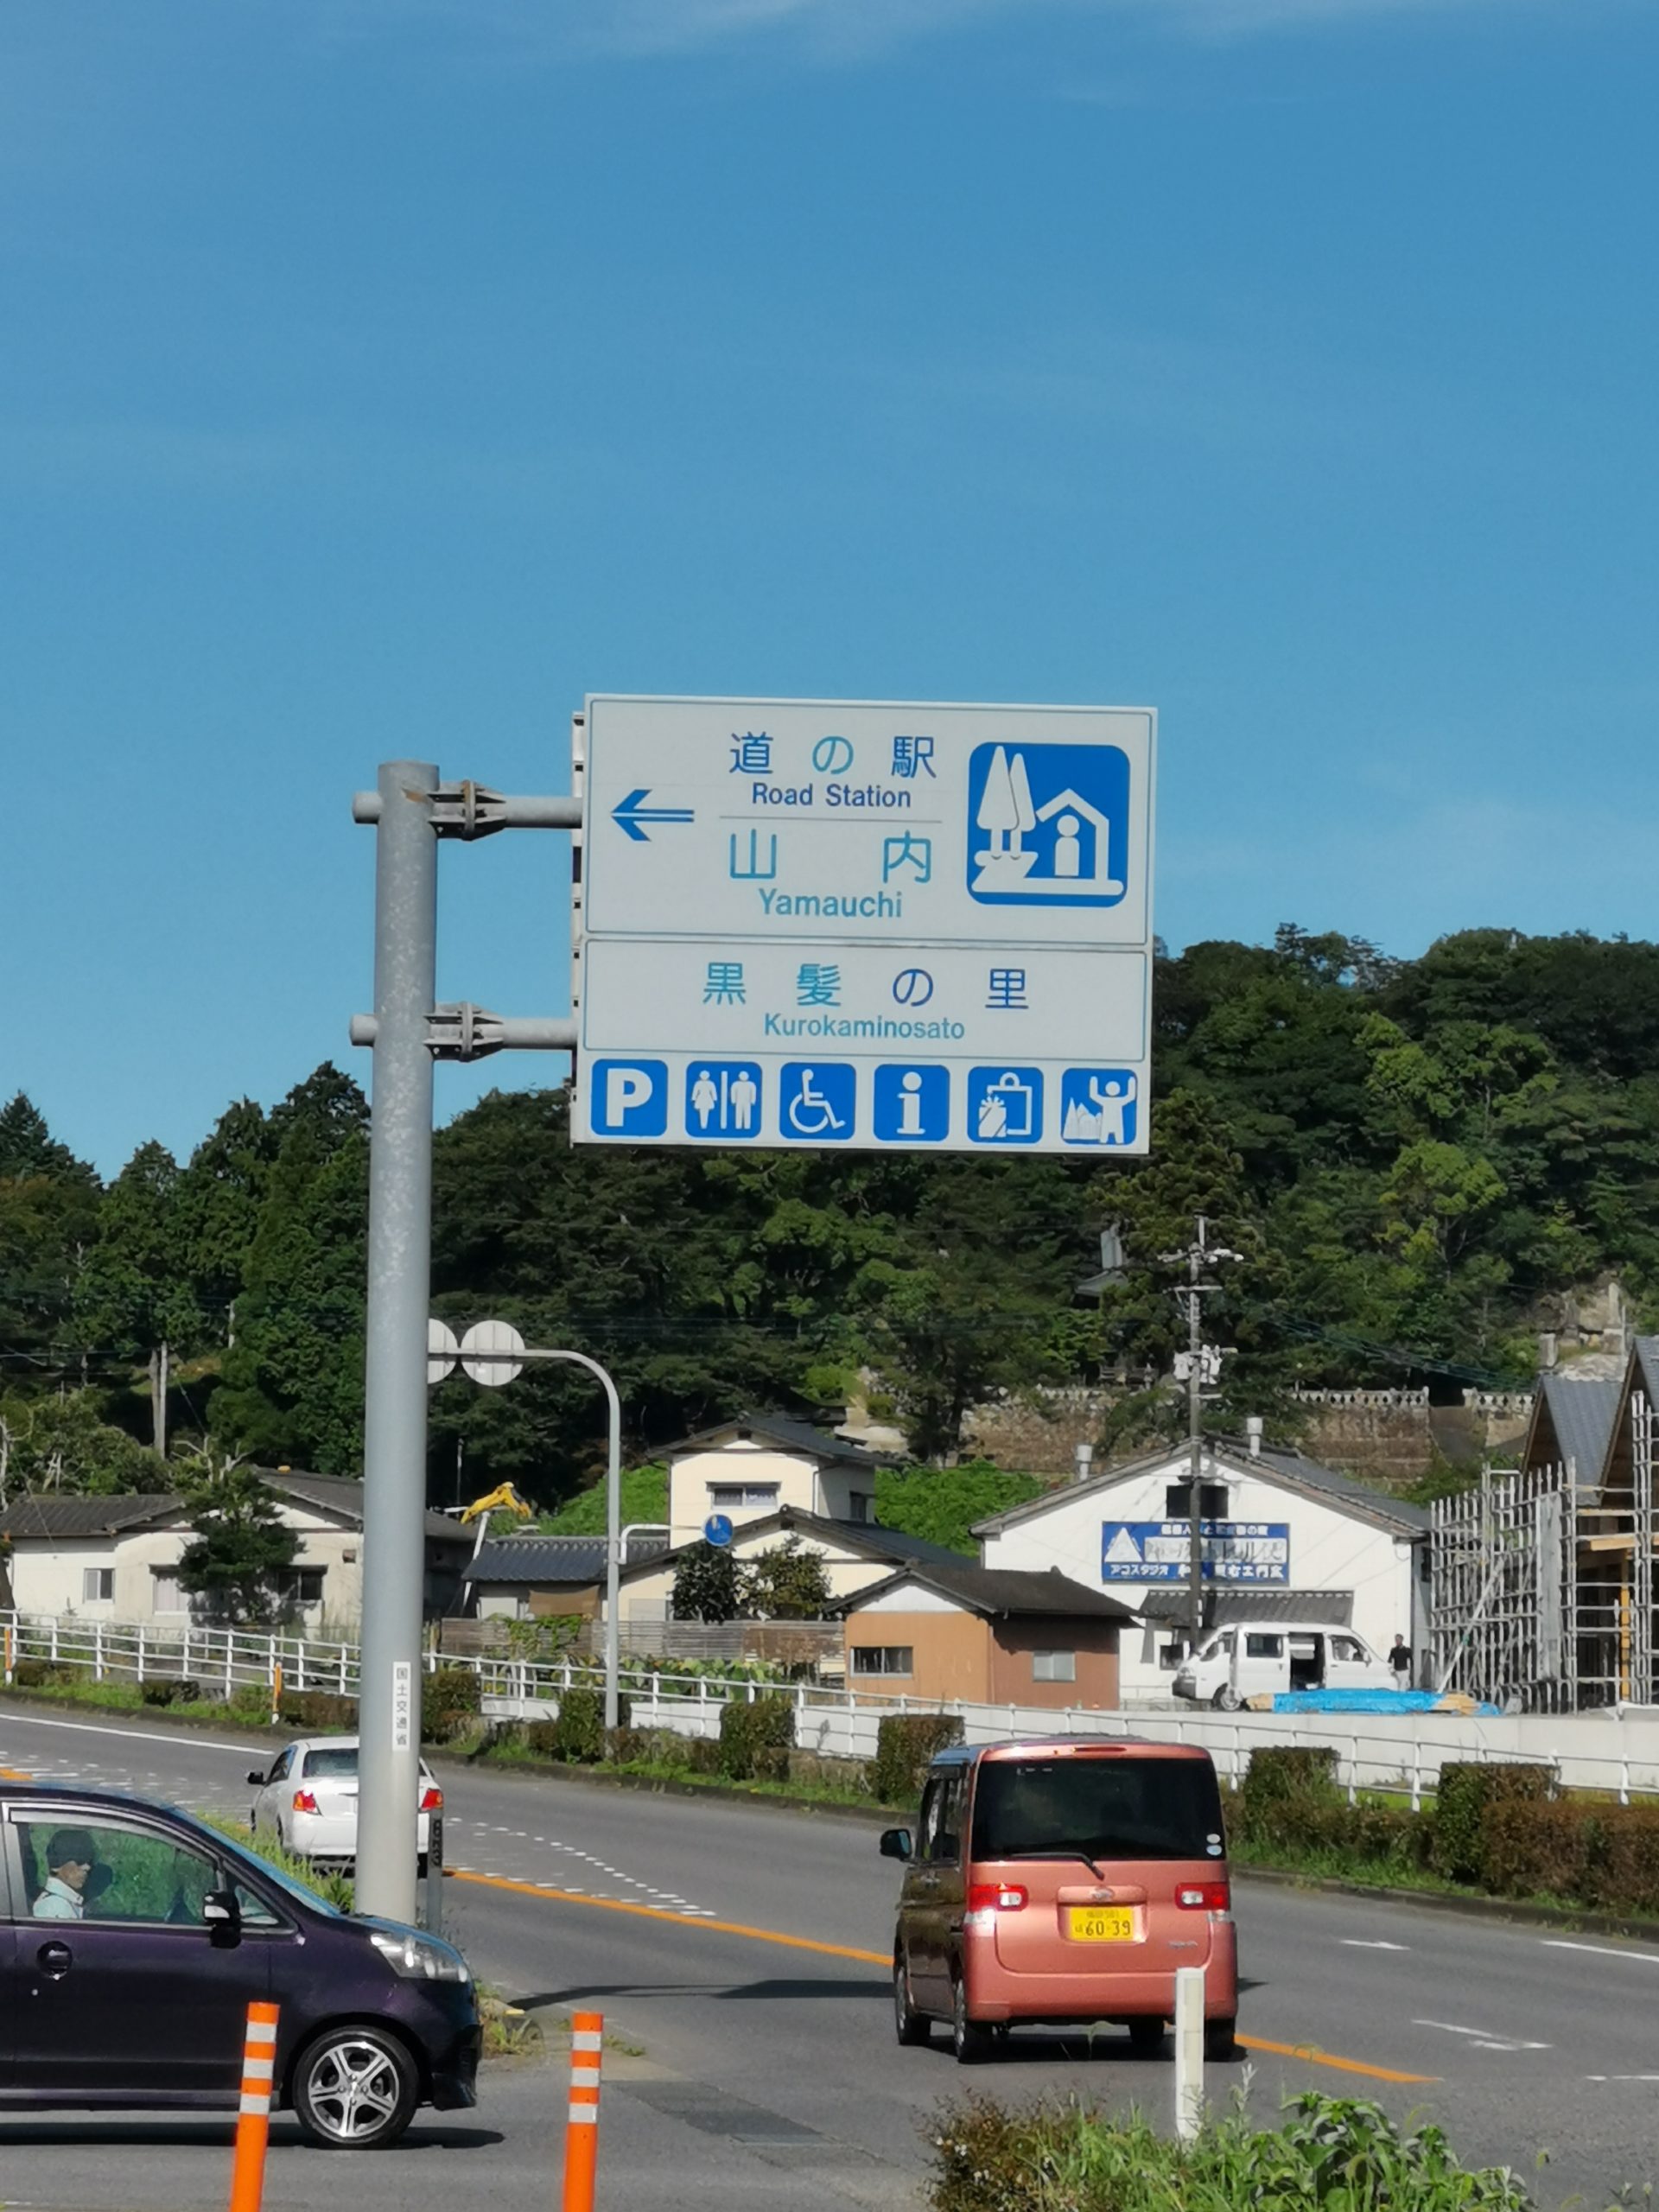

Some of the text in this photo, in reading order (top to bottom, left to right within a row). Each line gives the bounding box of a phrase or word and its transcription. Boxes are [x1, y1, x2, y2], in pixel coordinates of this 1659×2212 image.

[729, 732, 937, 778] 道の駅
[752, 782, 911, 808] Road Station
[730, 829, 931, 883] 山内
[759, 888, 901, 918] Yamauchi
[702, 962, 1029, 1009] 黒髪の里
[764, 1013, 965, 1039] Kurokaminosato
[607, 1068, 653, 1127] P
[397, 1667, 408, 1746] 国土交通省
